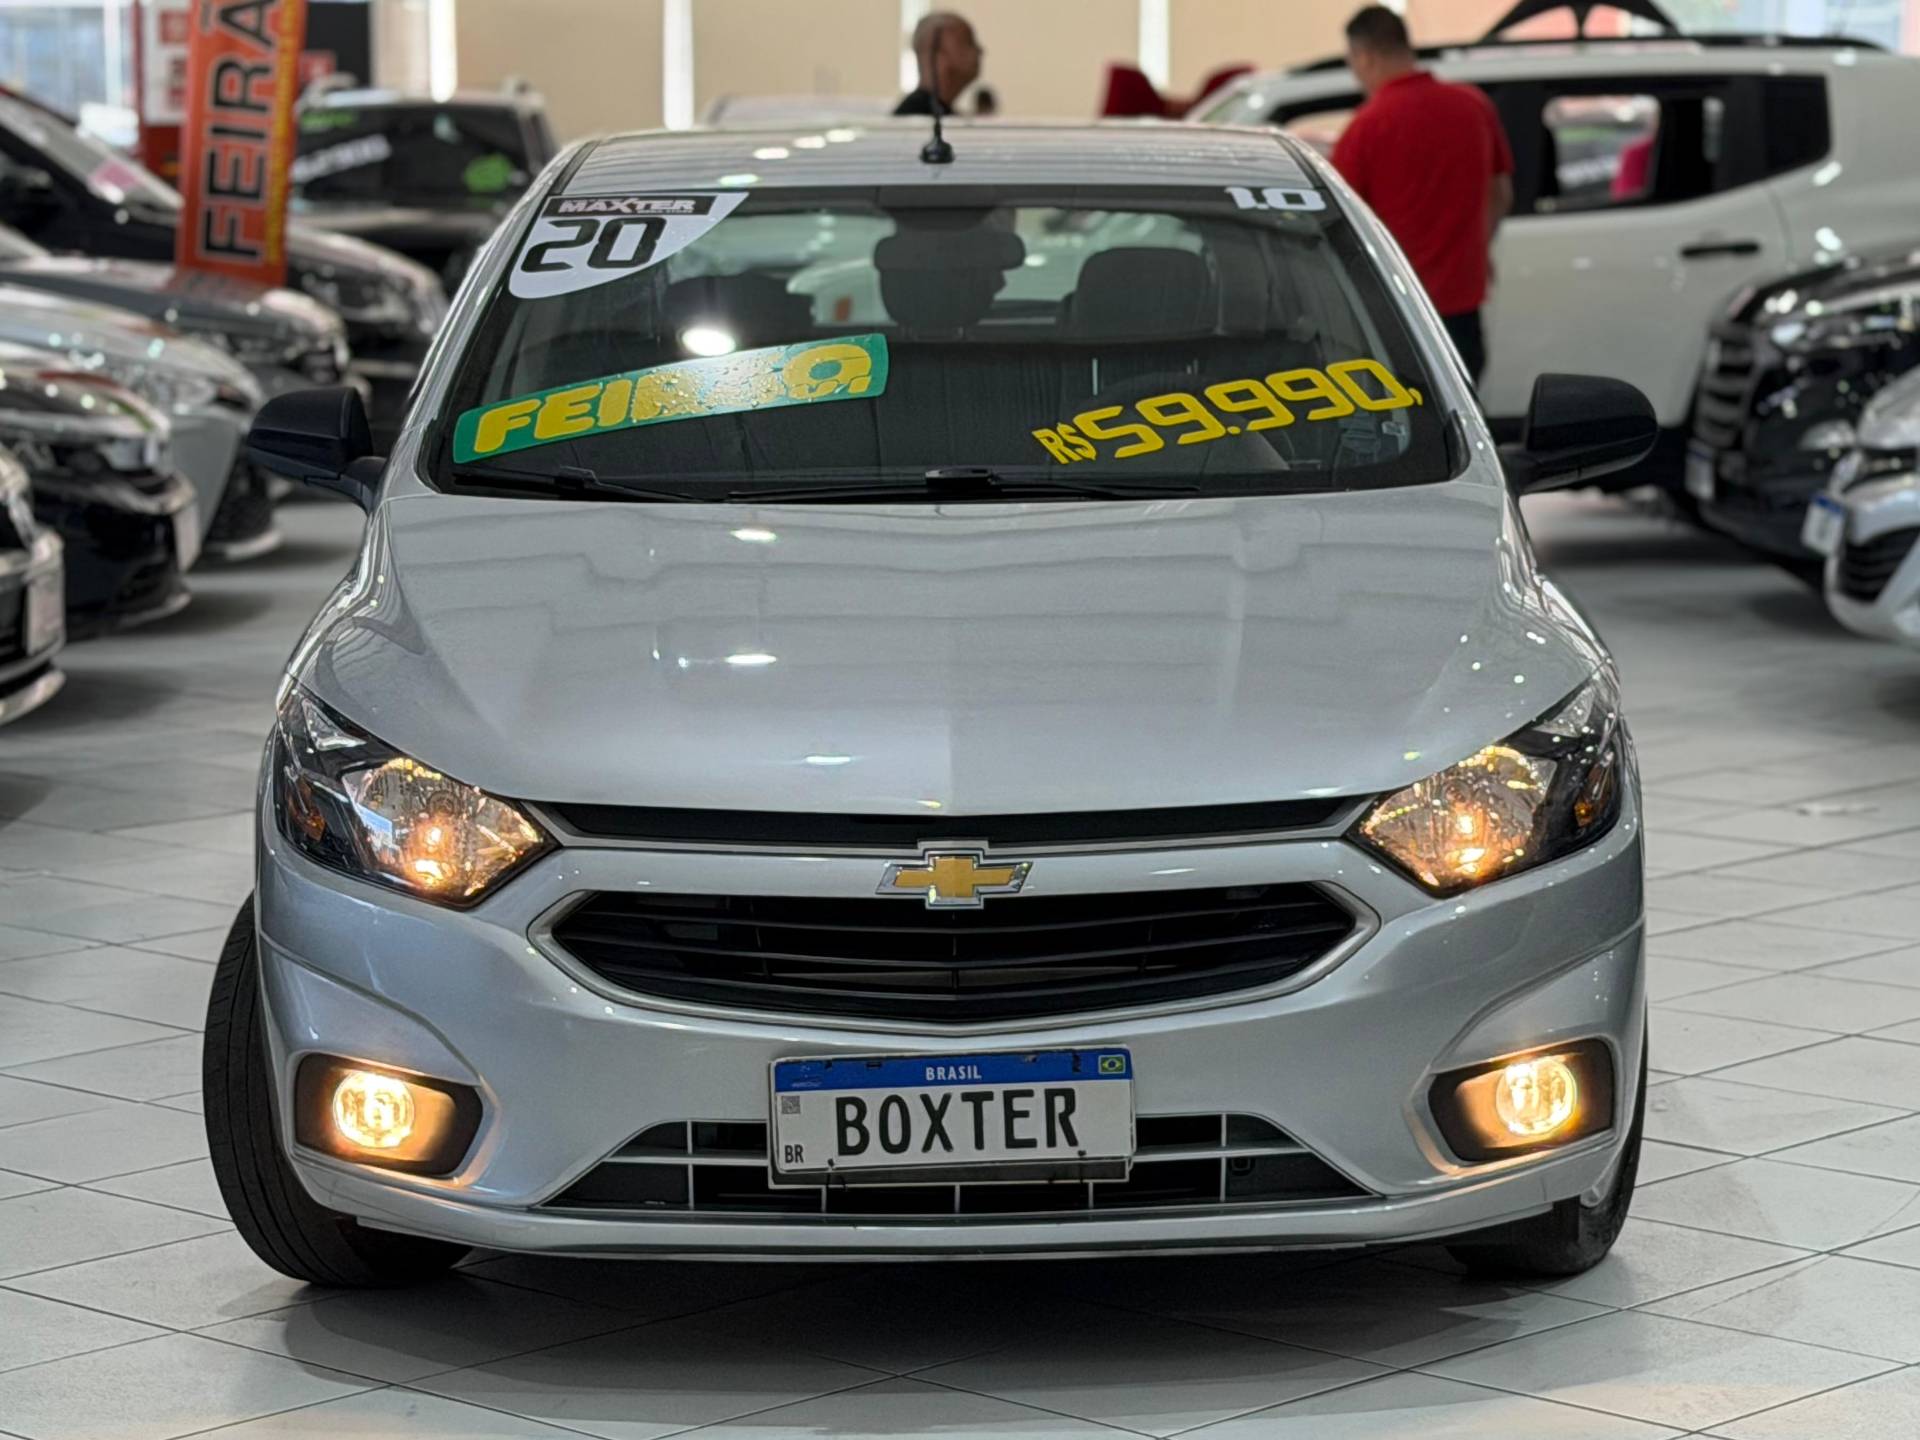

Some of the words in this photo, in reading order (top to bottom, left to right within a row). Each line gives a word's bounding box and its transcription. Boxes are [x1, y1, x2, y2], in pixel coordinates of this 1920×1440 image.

[558, 197, 696, 214] MAXTER
[1225, 186, 1327, 212] 1.0
[521, 216, 668, 273] 20
[925, 1065, 983, 1081] BRASIL
[835, 1087, 1079, 1156] BOXTER
[784, 1144, 804, 1164] BR
